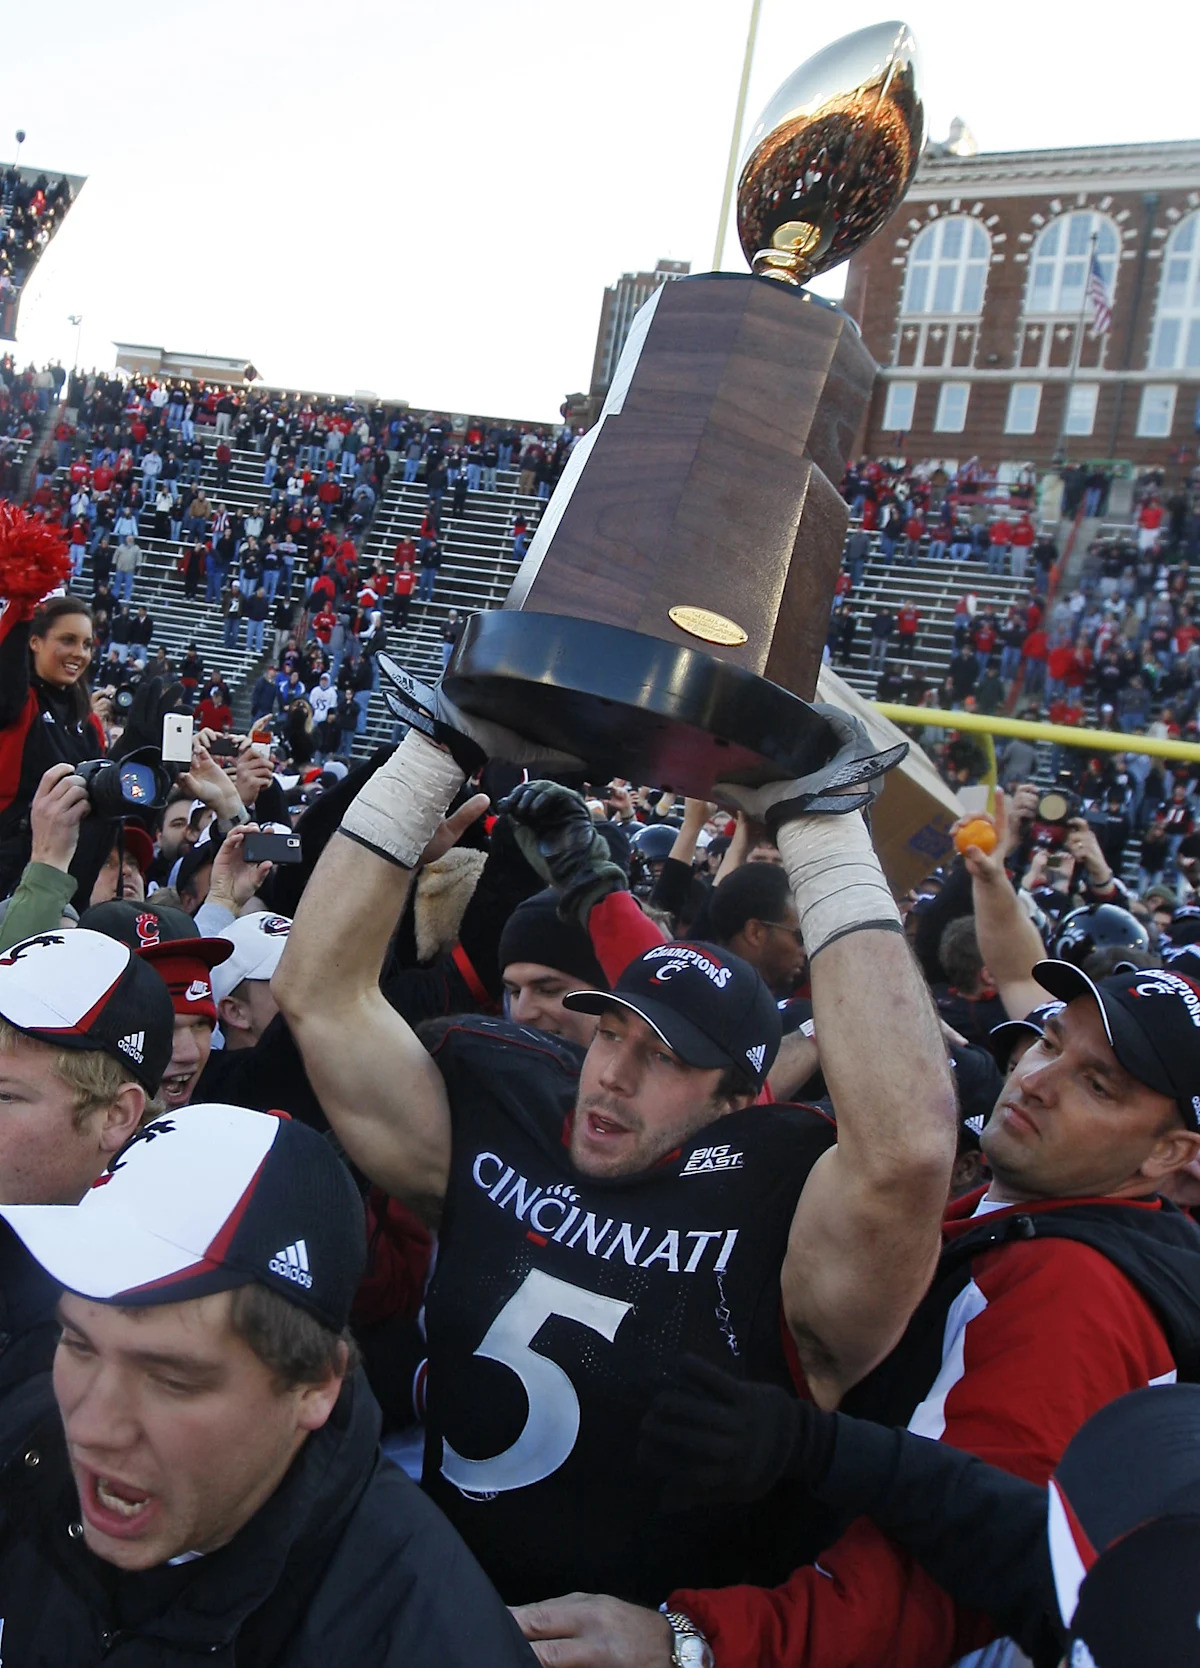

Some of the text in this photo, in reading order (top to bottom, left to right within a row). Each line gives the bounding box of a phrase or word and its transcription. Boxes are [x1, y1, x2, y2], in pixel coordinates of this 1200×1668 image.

[643, 945, 732, 988] CHAMPIONS
[117, 1039, 145, 1064] adidas
[684, 1152, 743, 1171] EAST
[689, 1145, 731, 1160] BIG
[471, 1151, 739, 1273] CINCINNATI
[269, 1259, 312, 1288] adidas
[440, 1267, 634, 1493] 5
